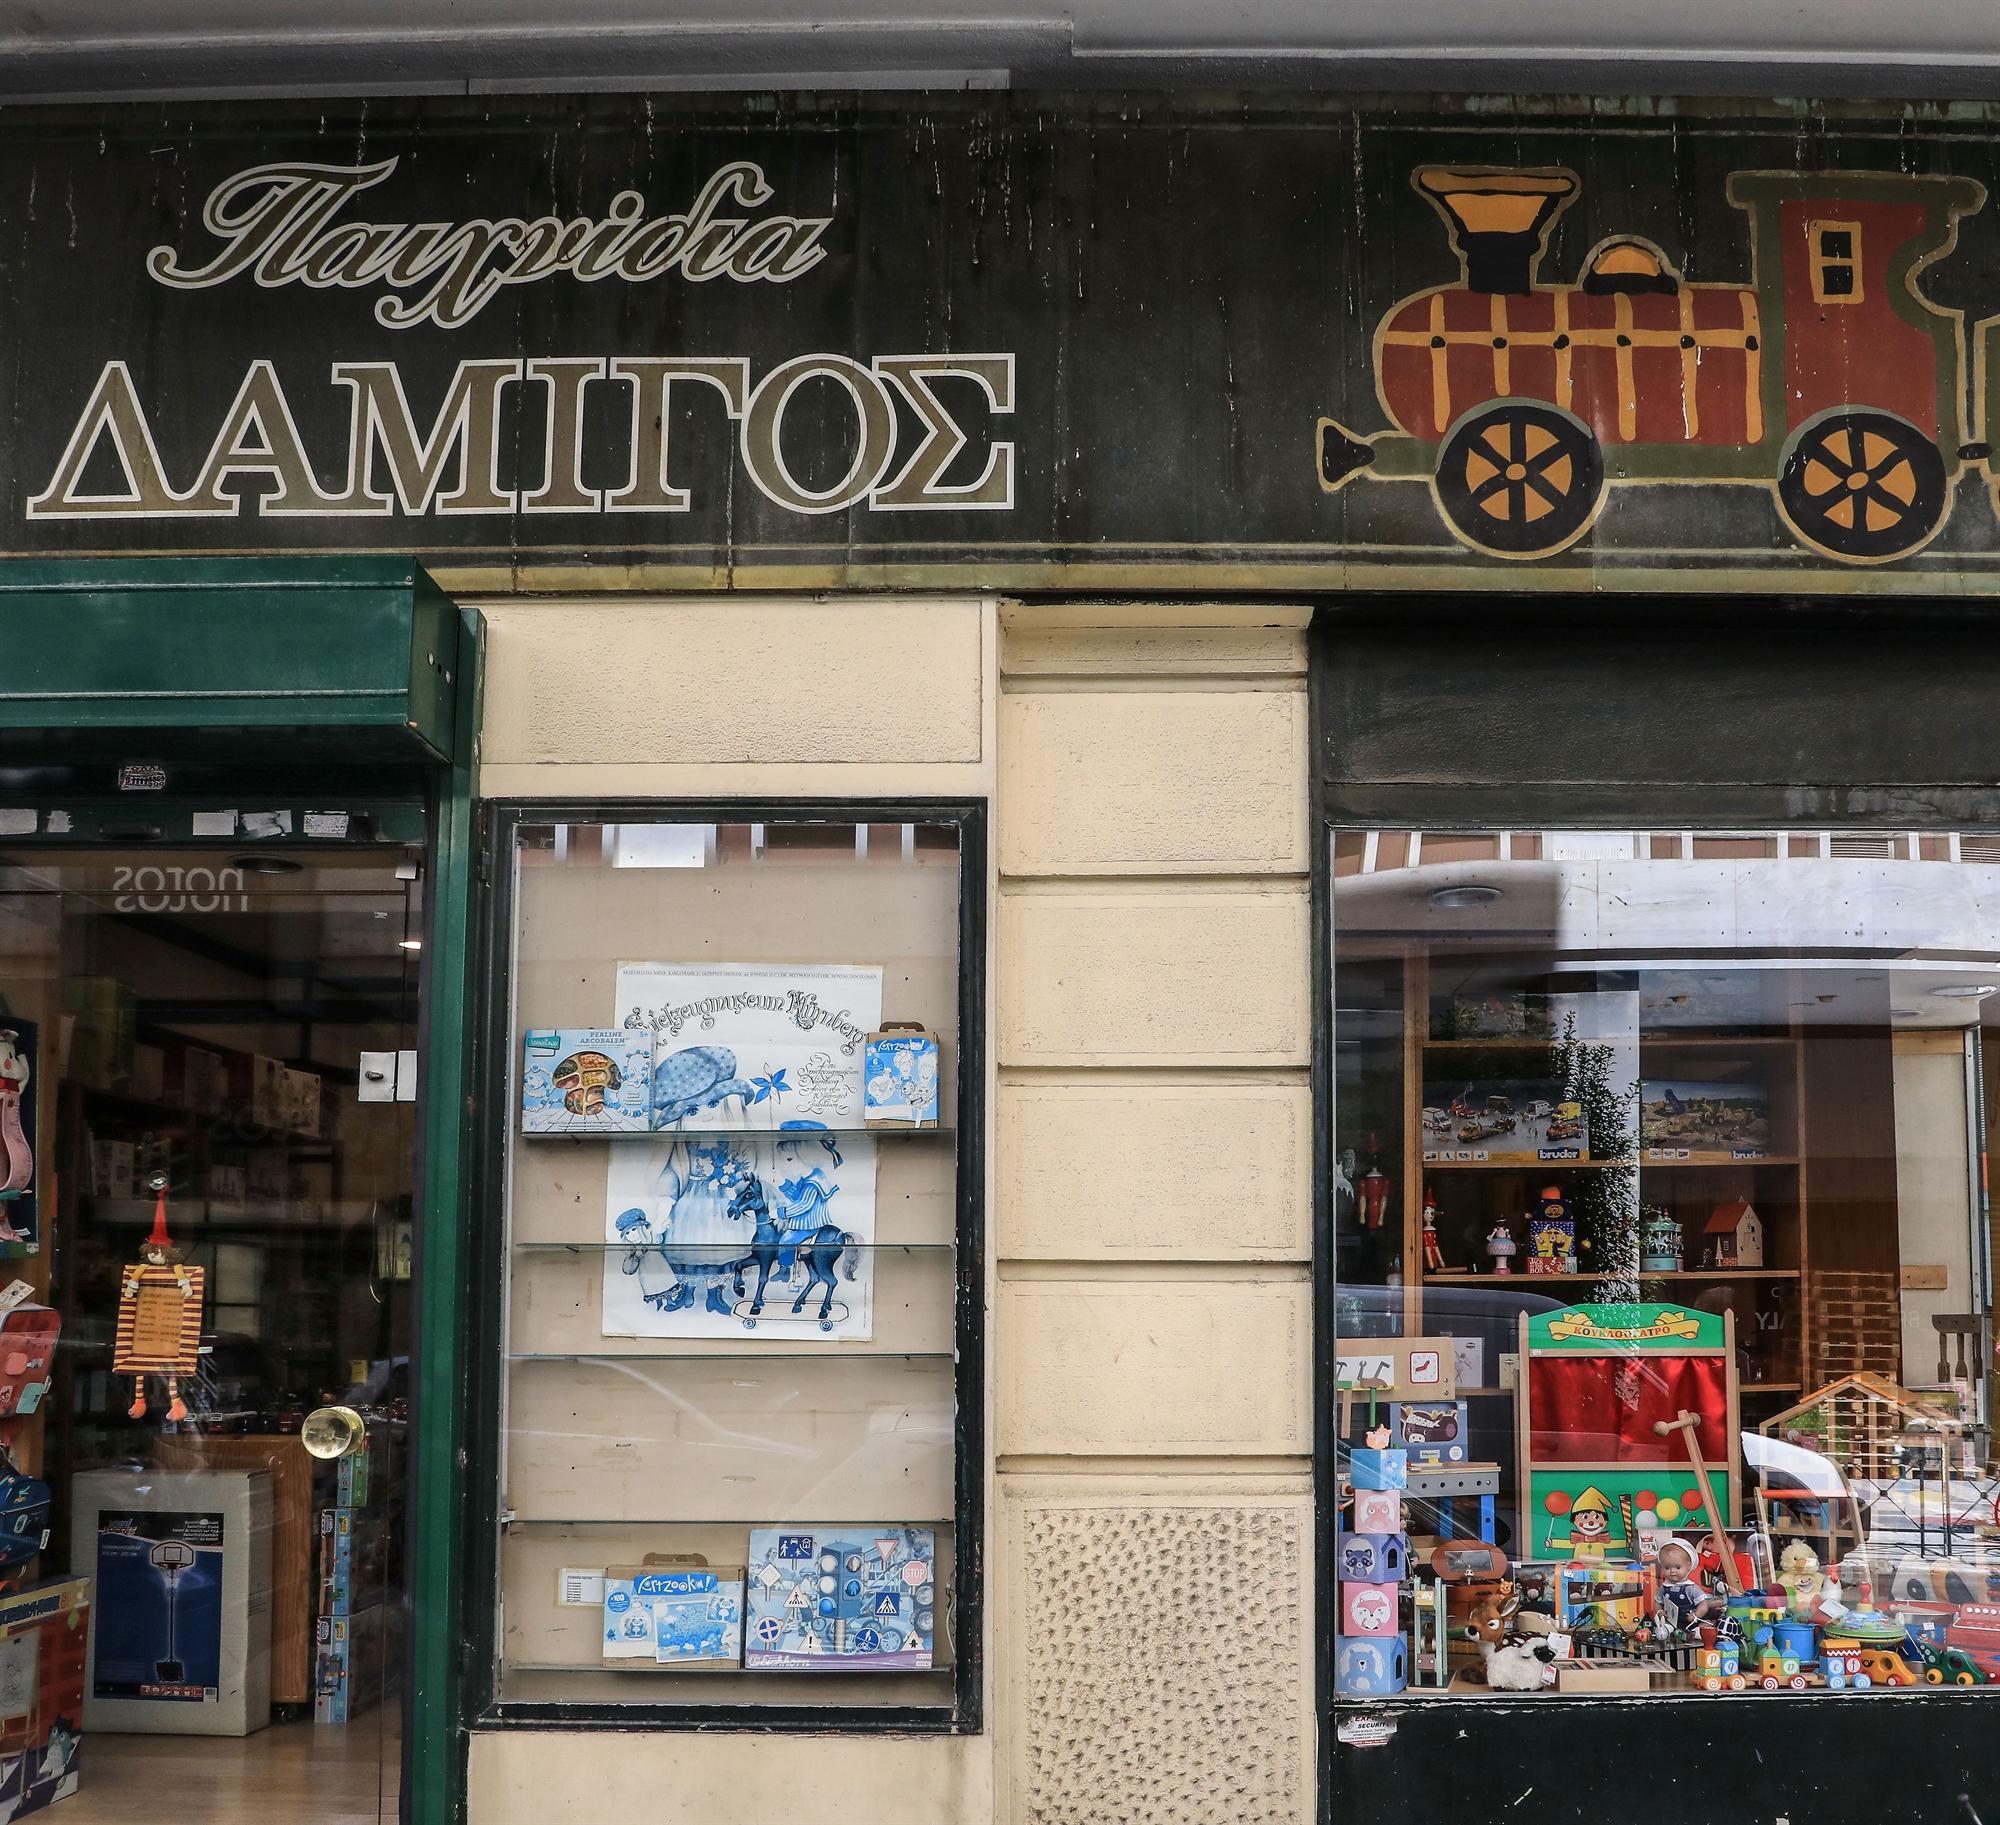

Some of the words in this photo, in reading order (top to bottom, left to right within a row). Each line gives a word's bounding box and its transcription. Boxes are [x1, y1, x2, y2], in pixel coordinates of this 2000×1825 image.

[26, 352, 1016, 520] ΔΑΜΙΓΟΣ
[1539, 1149, 1578, 1159] bruder
[1732, 1150, 1764, 1159] bruder
[905, 1568, 925, 1579] STOP
[637, 1575, 711, 1594] Artzooka!
[760, 1655, 811, 1667] Eichhorn
